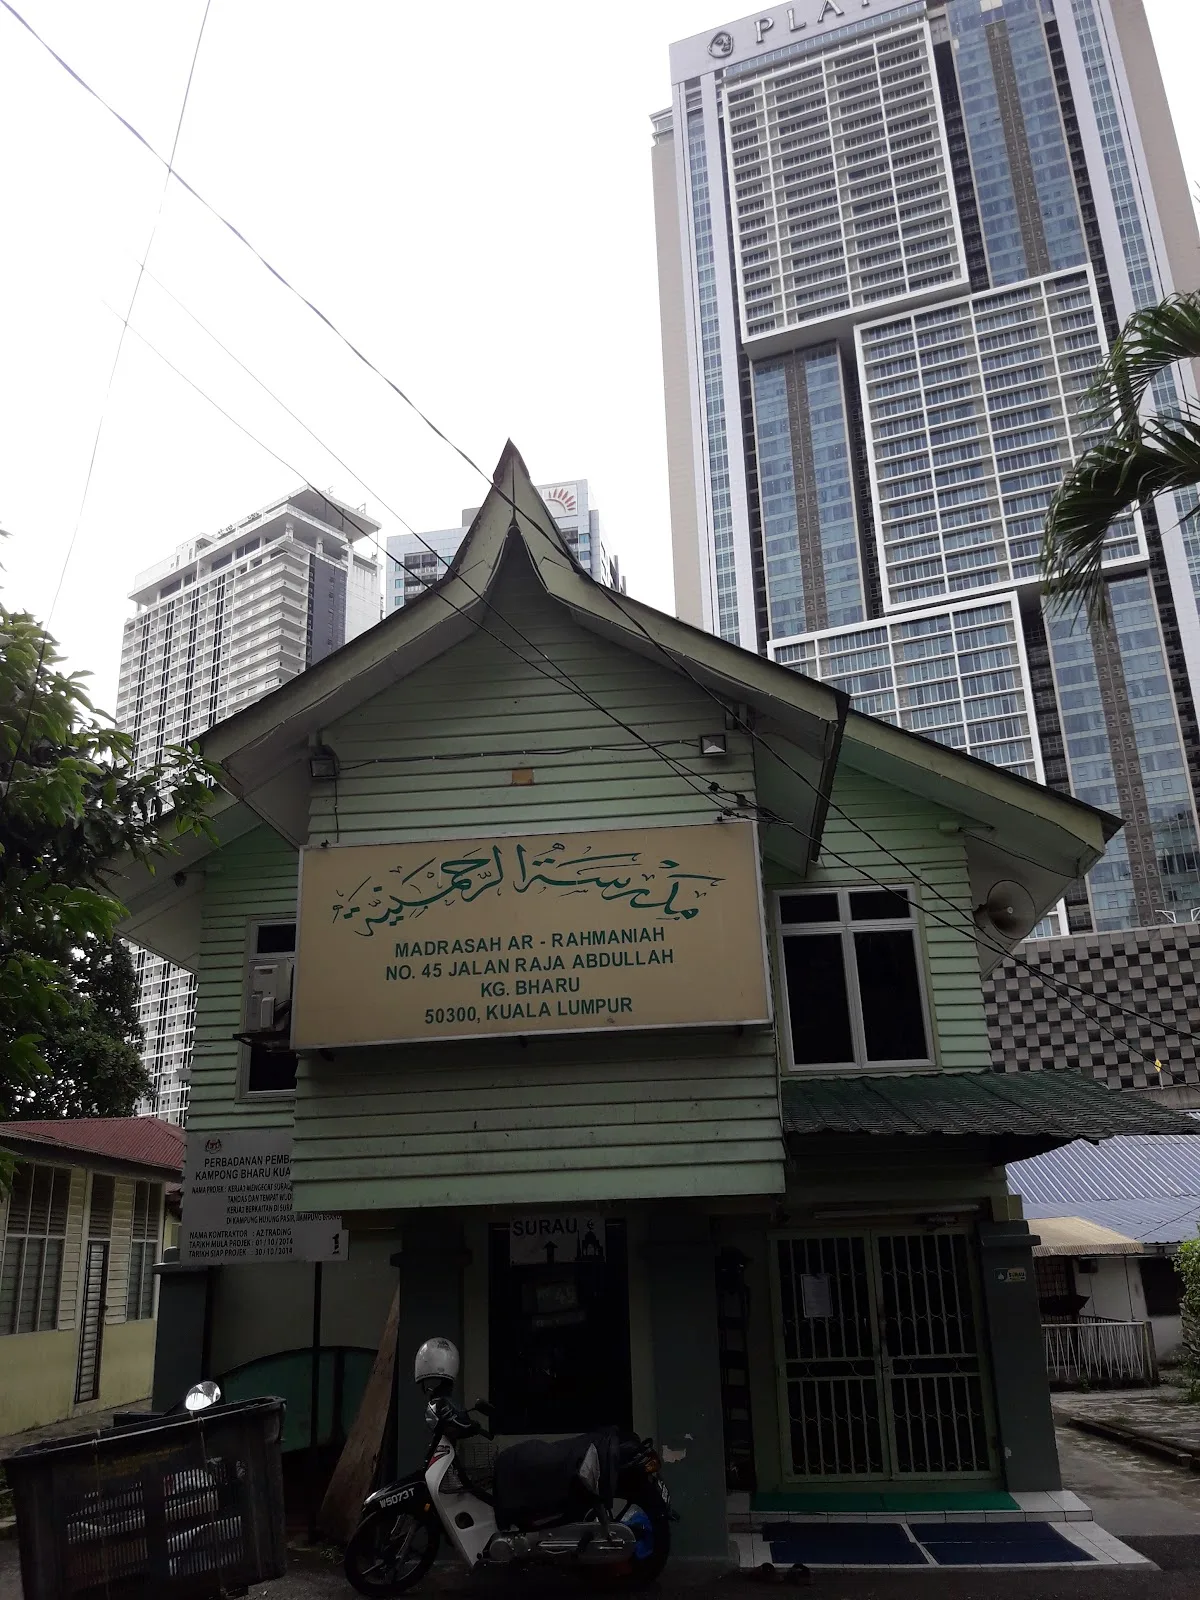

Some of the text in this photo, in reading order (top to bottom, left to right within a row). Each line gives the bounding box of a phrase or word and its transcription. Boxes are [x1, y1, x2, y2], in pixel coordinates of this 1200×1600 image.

[754, 0, 869, 44] PLA
[395, 937, 501, 958] MADRASAH
[508, 935, 533, 951] AR
[552, 927, 665, 948] RAHMANIAH
[386, 949, 673, 981] NO. 45 JALAN RAJA ABDULLAH
[481, 977, 580, 997] KG. BHARU
[425, 997, 633, 1024] 50300, KUALA LUMPUR
[204, 1154, 293, 1168] PERBADANAN PEMB
[195, 1170, 238, 1181] KAMPONG
[241, 1168, 271, 1179] BHARU
[192, 1186, 206, 1194] NAMA
[189, 1231, 208, 1239] NAMA
[209, 1229, 248, 1239] KONTRAKTOR
[265, 1228, 292, 1237] TRADING
[512, 1218, 578, 1236] SURAU
[189, 1240, 210, 1248] TARIKH
[211, 1240, 228, 1248] MULA
[189, 1250, 209, 1258] TARIKH
[379, 1487, 415, 1509] W5073T
